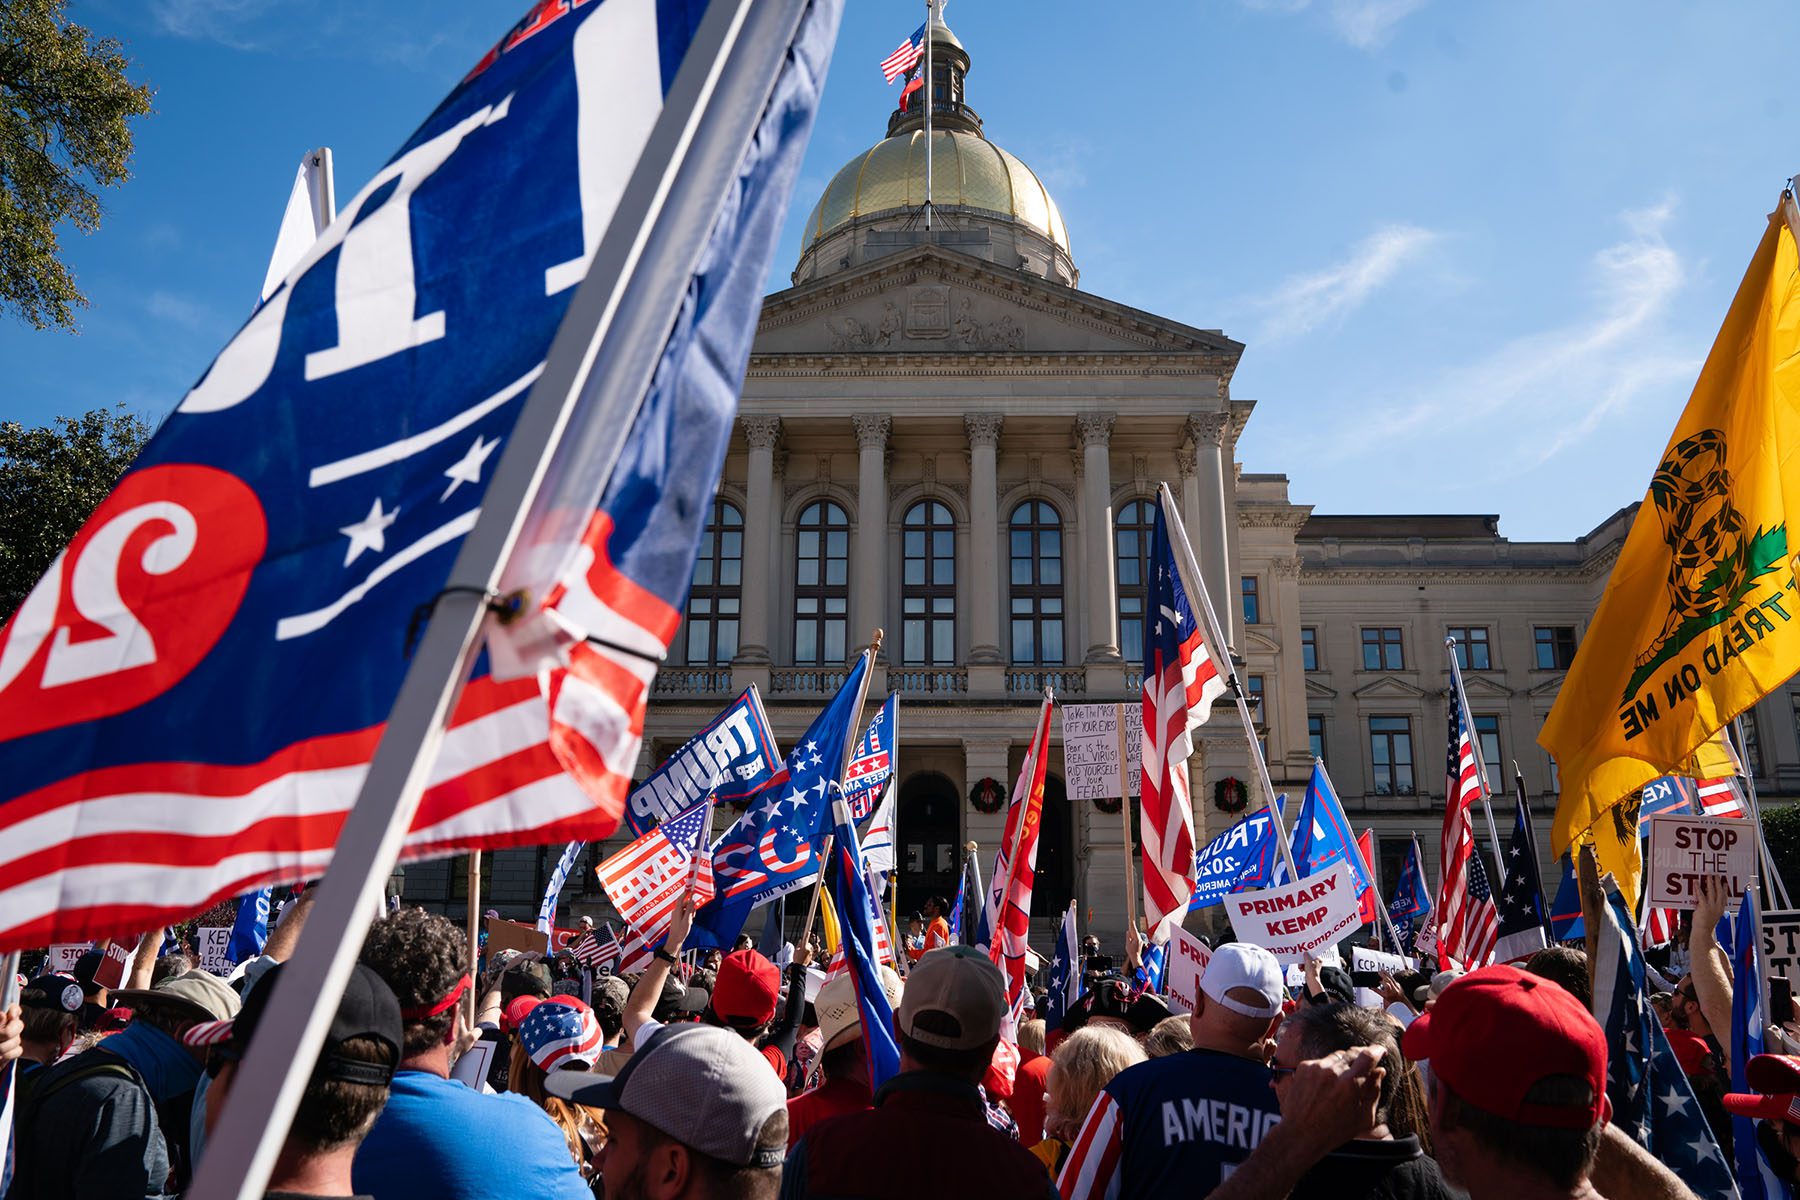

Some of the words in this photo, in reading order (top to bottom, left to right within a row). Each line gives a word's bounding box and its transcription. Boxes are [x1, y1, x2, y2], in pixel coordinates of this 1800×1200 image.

[1065, 721, 1080, 733] OFF
[1081, 720, 1098, 732] YOUR
[1067, 752, 1088, 763] REAL
[1067, 765, 1081, 777] RID
[1083, 764, 1118, 778] YOURSELF
[1071, 776, 1081, 786] OF
[1077, 784, 1109, 799] FEAR!
[1675, 826, 1738, 851] STOP
[1688, 851, 1728, 873] THE
[1239, 873, 1338, 917] PRIMARY
[1266, 906, 1329, 937] KEMP
[1358, 959, 1376, 971] CCP
